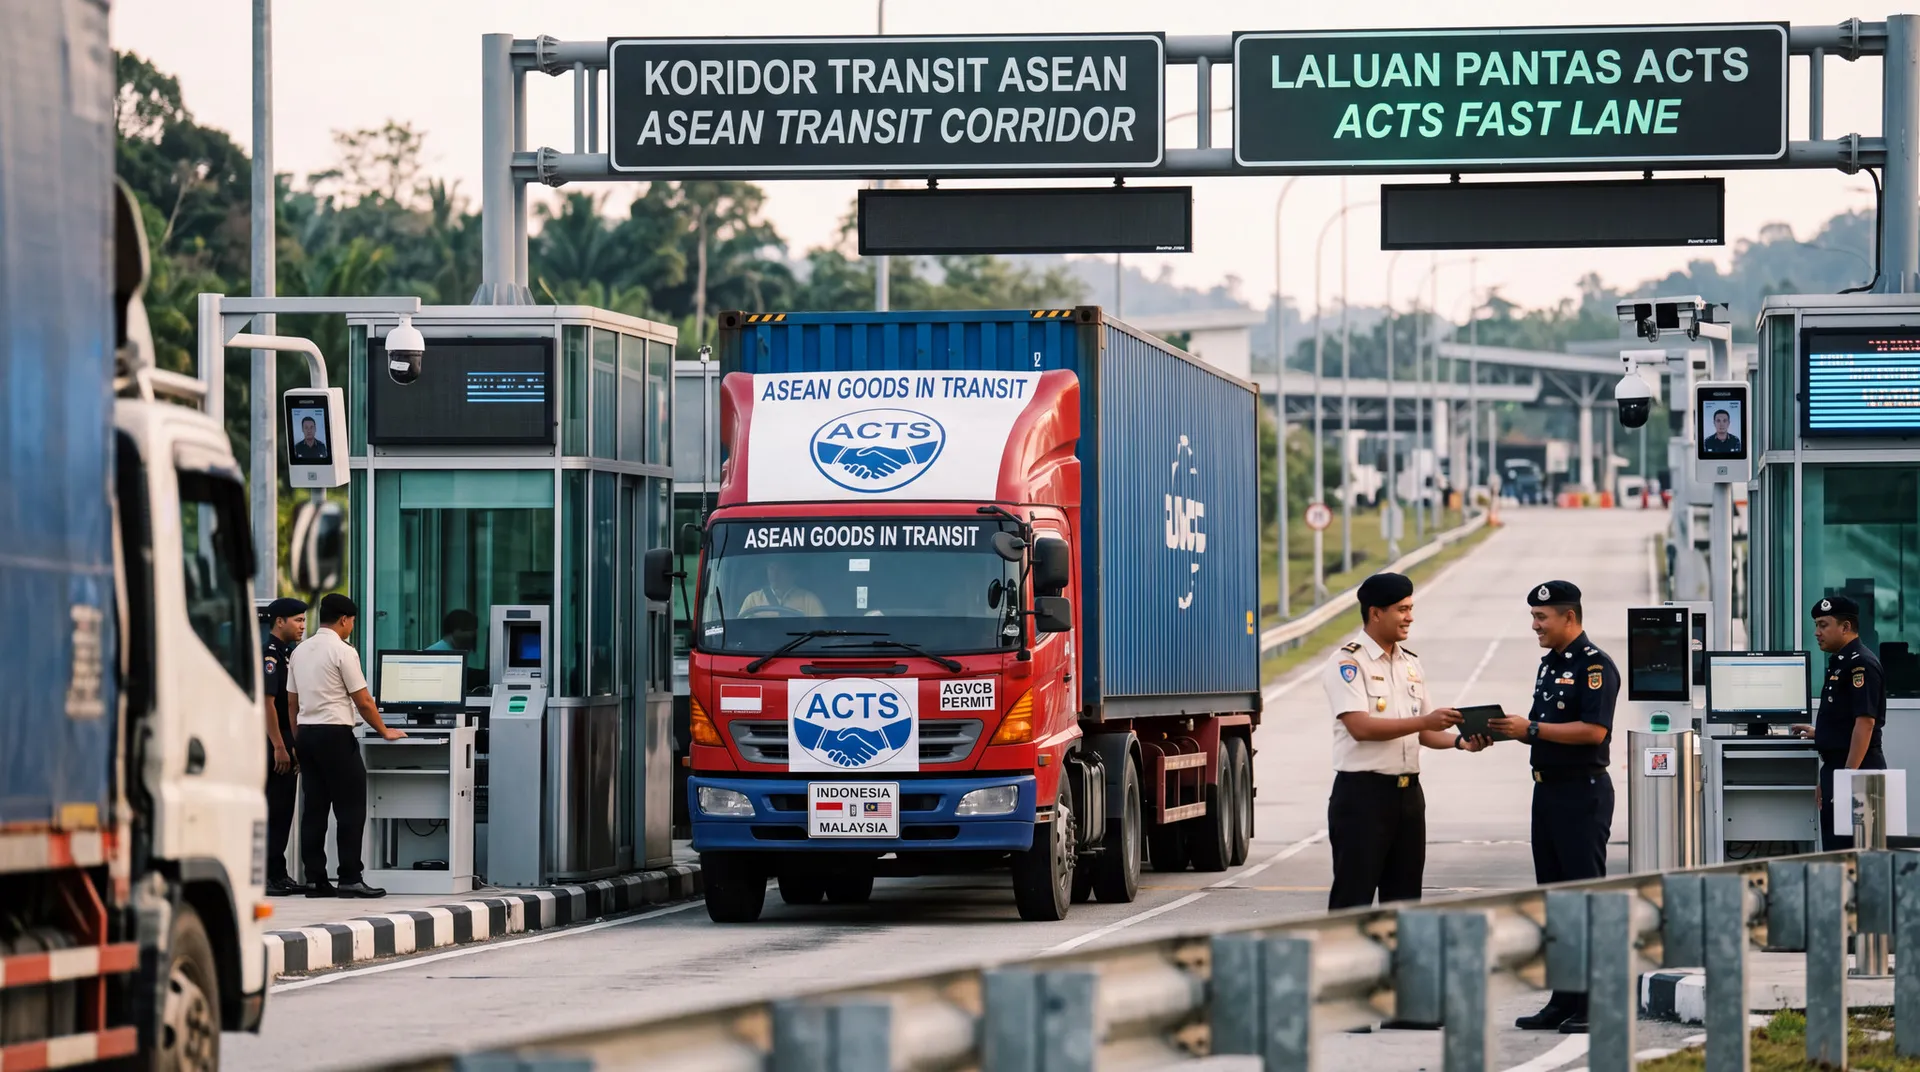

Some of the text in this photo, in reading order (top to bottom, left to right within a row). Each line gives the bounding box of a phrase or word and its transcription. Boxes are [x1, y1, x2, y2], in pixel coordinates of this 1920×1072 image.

[645, 55, 1127, 96] KORIDOR TRANSIT ASEAN
[1271, 46, 1749, 89] LALUAN PANTAS ACTS
[636, 106, 1136, 146] ASEAN TRANSIT CORRIDOR
[1333, 98, 1682, 139] ACTS FAST LANE
[761, 376, 1028, 402] ASEAN GOODS IN TRANSIT
[826, 422, 932, 440] ACTS
[744, 525, 980, 549] ASEAN GOODS IN TRANSIT
[942, 682, 993, 695] AGVCB
[806, 692, 900, 720] ACTS
[941, 696, 994, 709] PERMIT
[816, 787, 891, 799] INDONESIA
[819, 822, 888, 834] MALAYSIA
